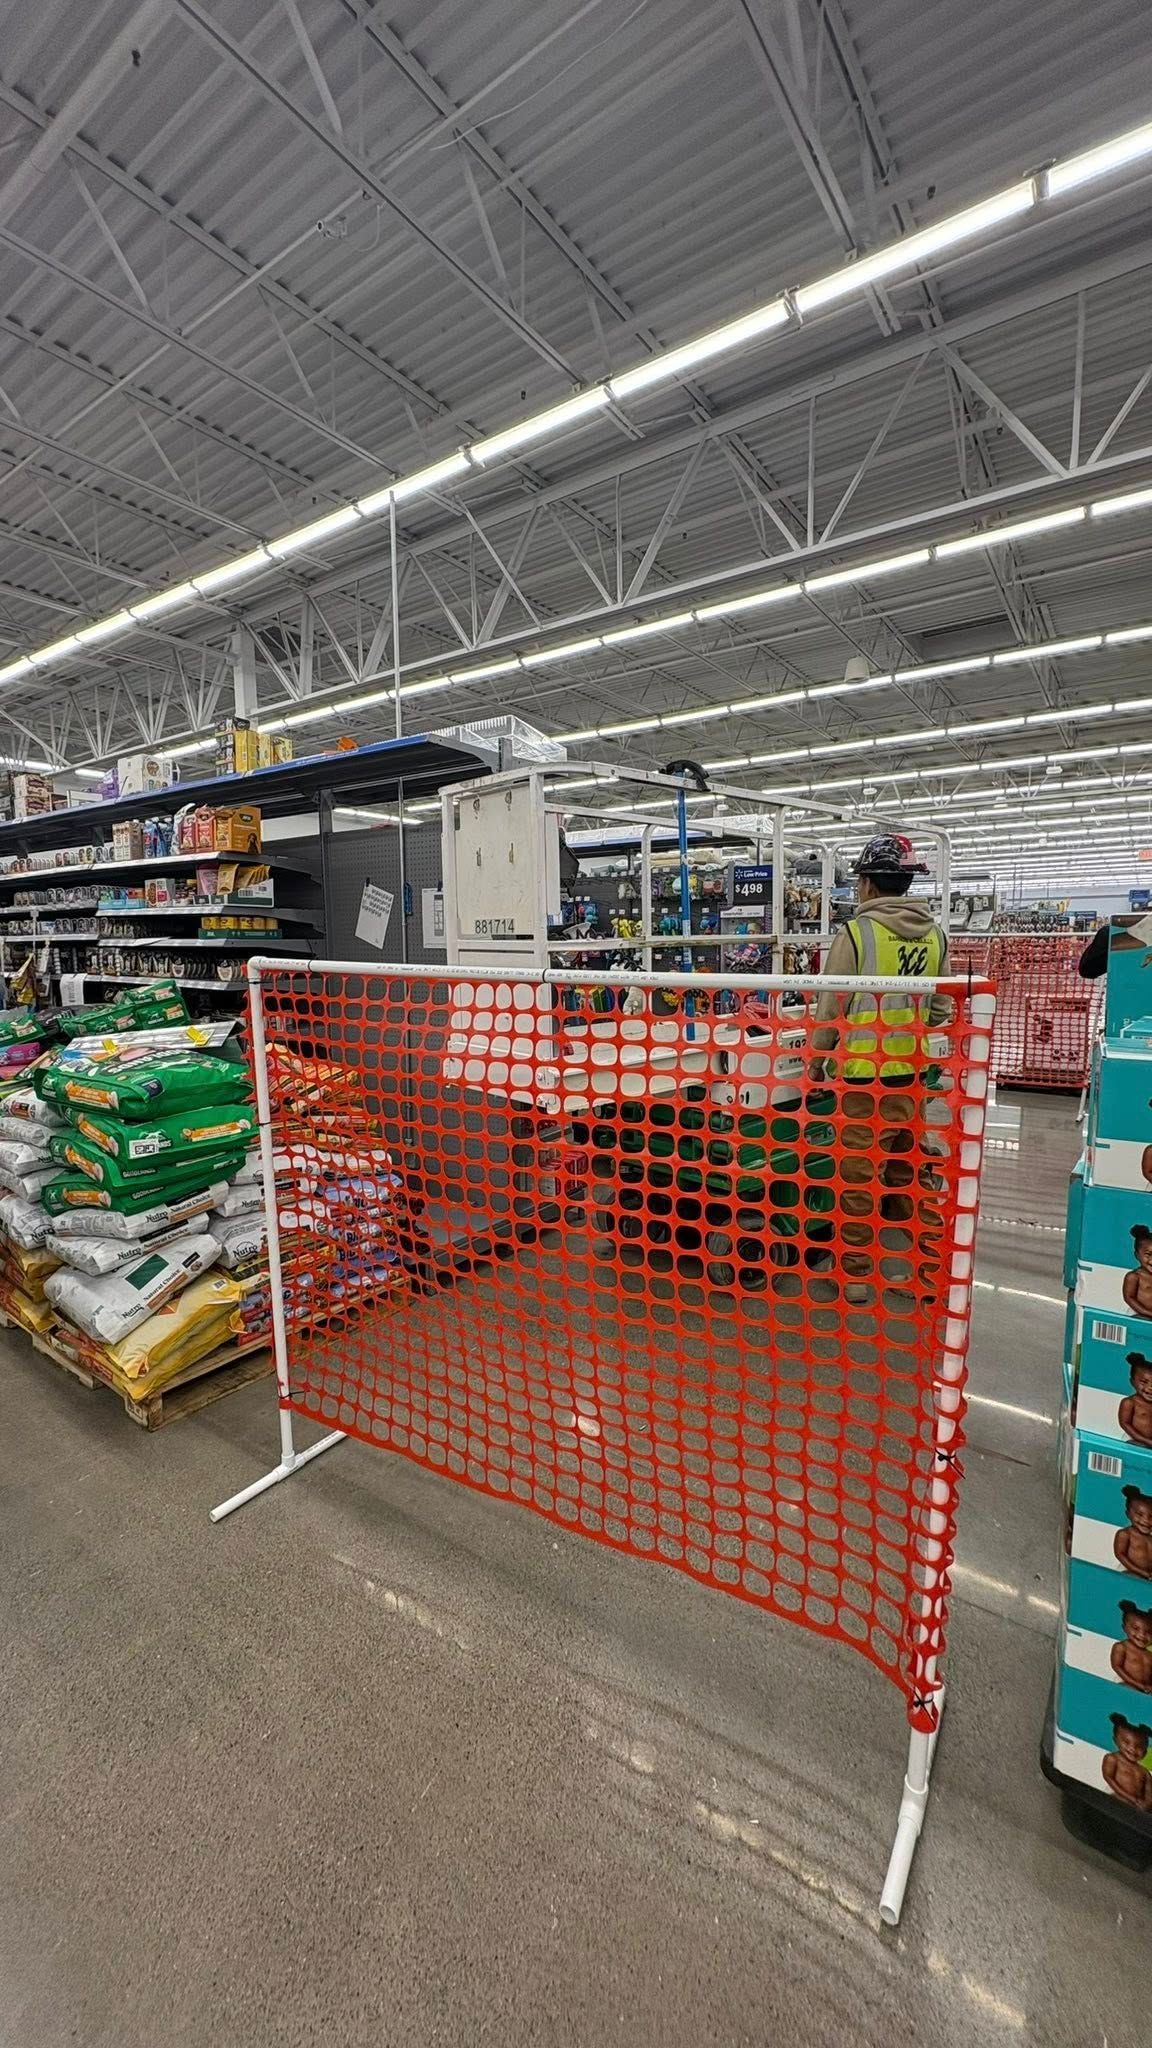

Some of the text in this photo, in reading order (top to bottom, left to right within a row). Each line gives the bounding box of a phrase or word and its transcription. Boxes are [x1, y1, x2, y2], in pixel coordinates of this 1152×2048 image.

[735, 883, 763, 897] $498
[475, 918, 515, 934] 881714
[145, 1193, 211, 1223] Nutro Natural Choice
[117, 1247, 142, 1260] Nutro
[233, 1244, 258, 1258] Nutro
[122, 1269, 180, 1319] Nutro Natural Choice
